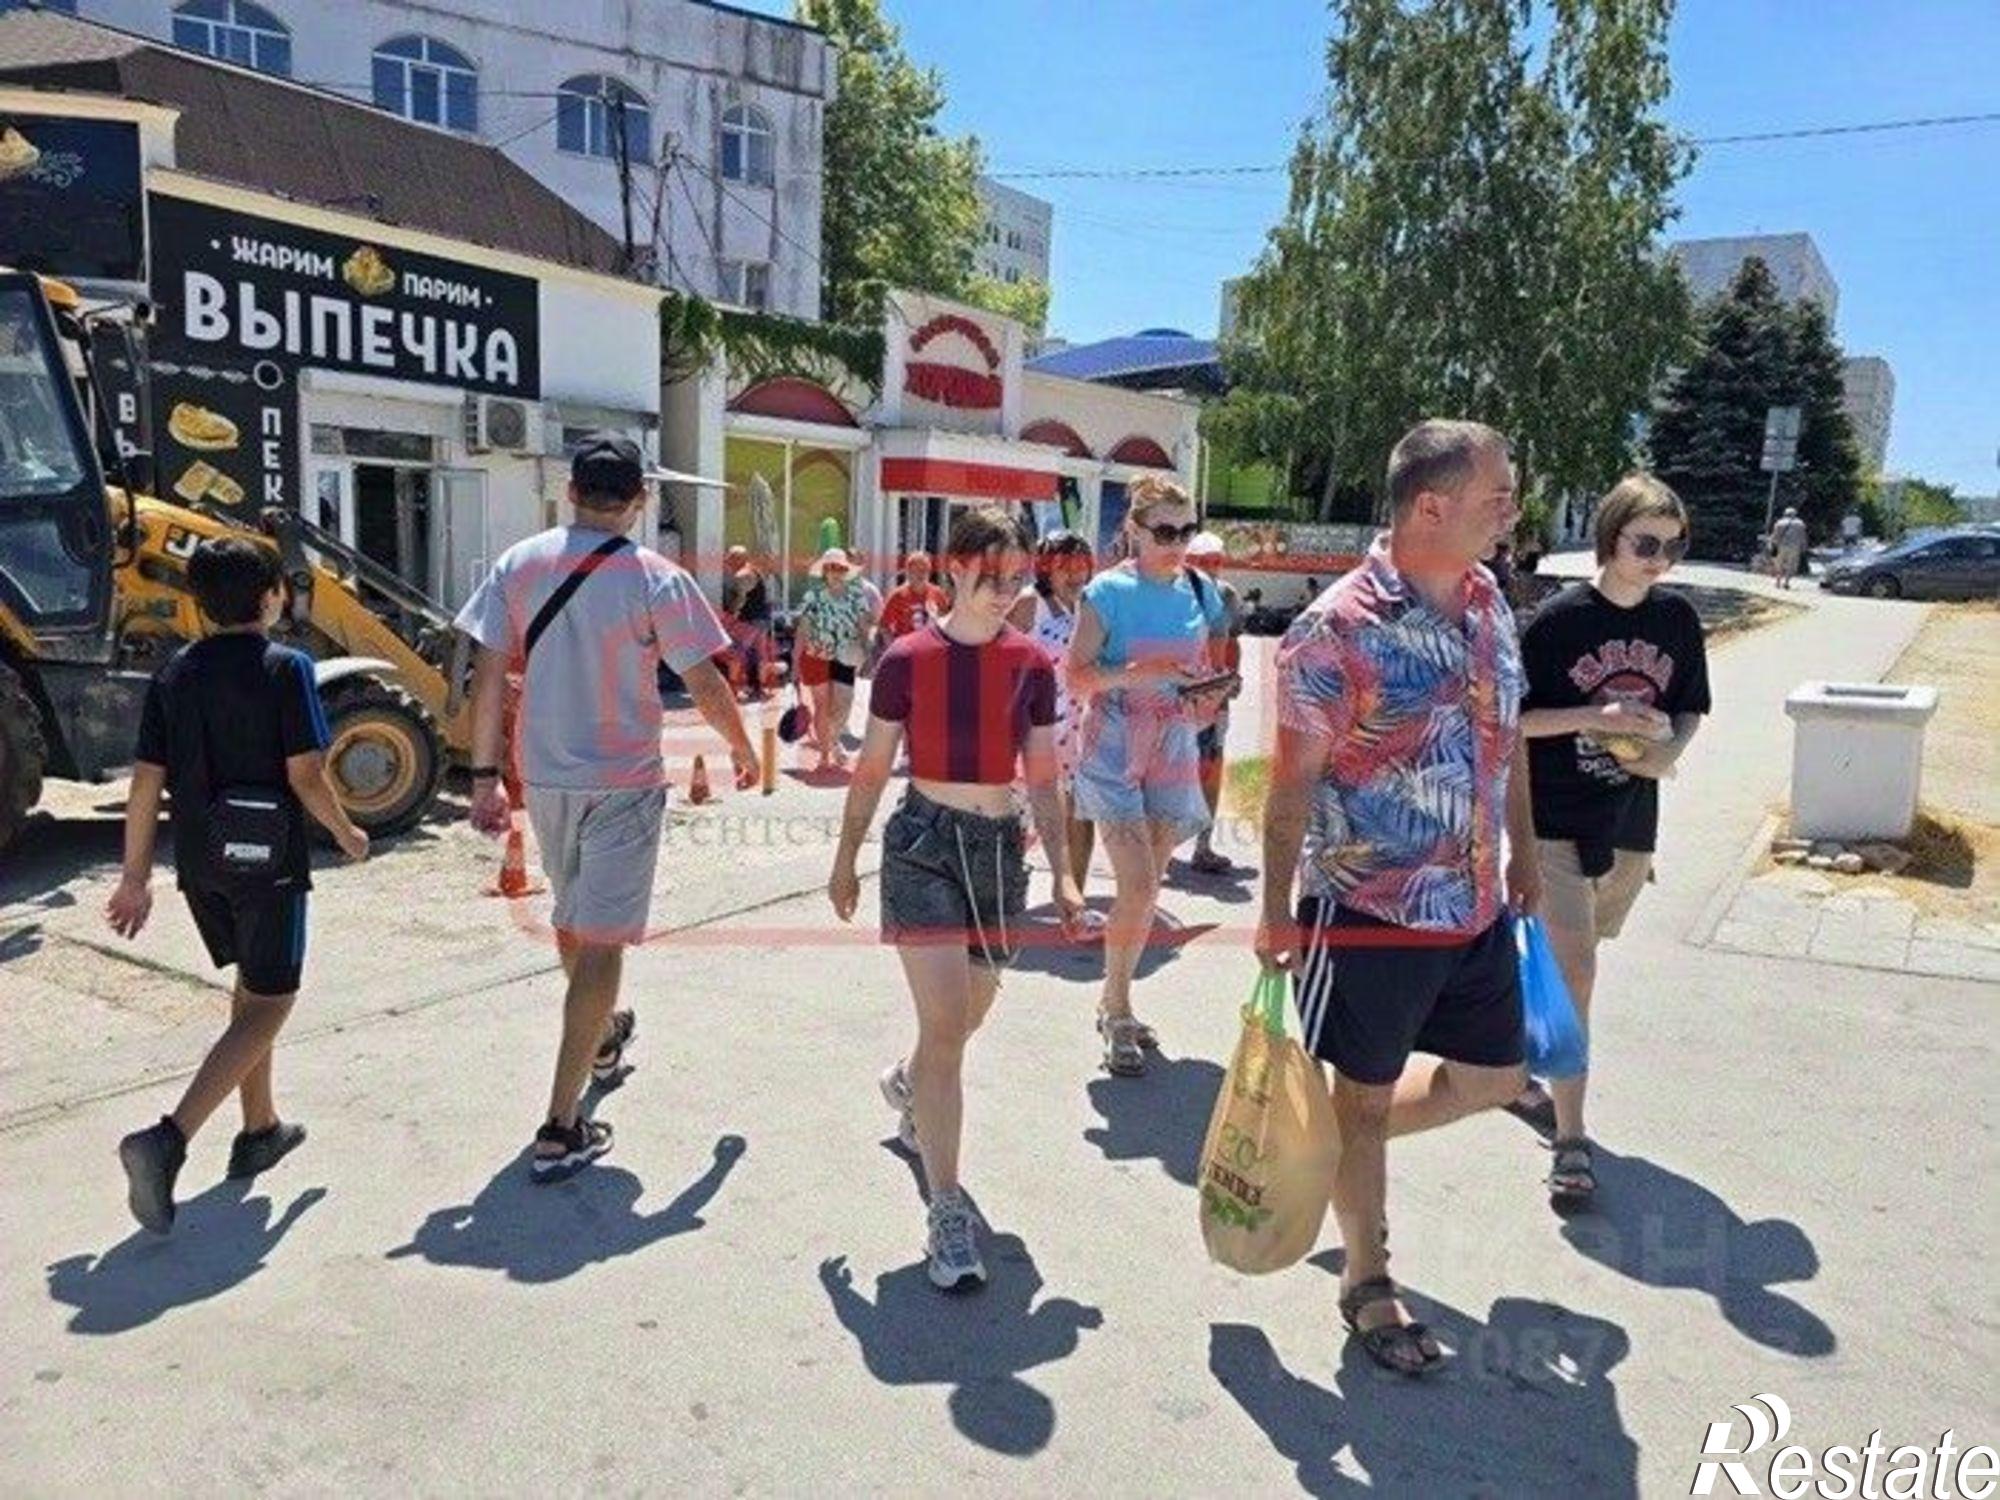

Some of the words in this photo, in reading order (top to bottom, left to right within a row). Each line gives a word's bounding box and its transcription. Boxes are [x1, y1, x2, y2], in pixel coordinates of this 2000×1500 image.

[232, 236, 333, 280] ЖАРИМ
[404, 272, 481, 309] ПАРИМ
[184, 271, 519, 386] ВЫПЕЧКА
